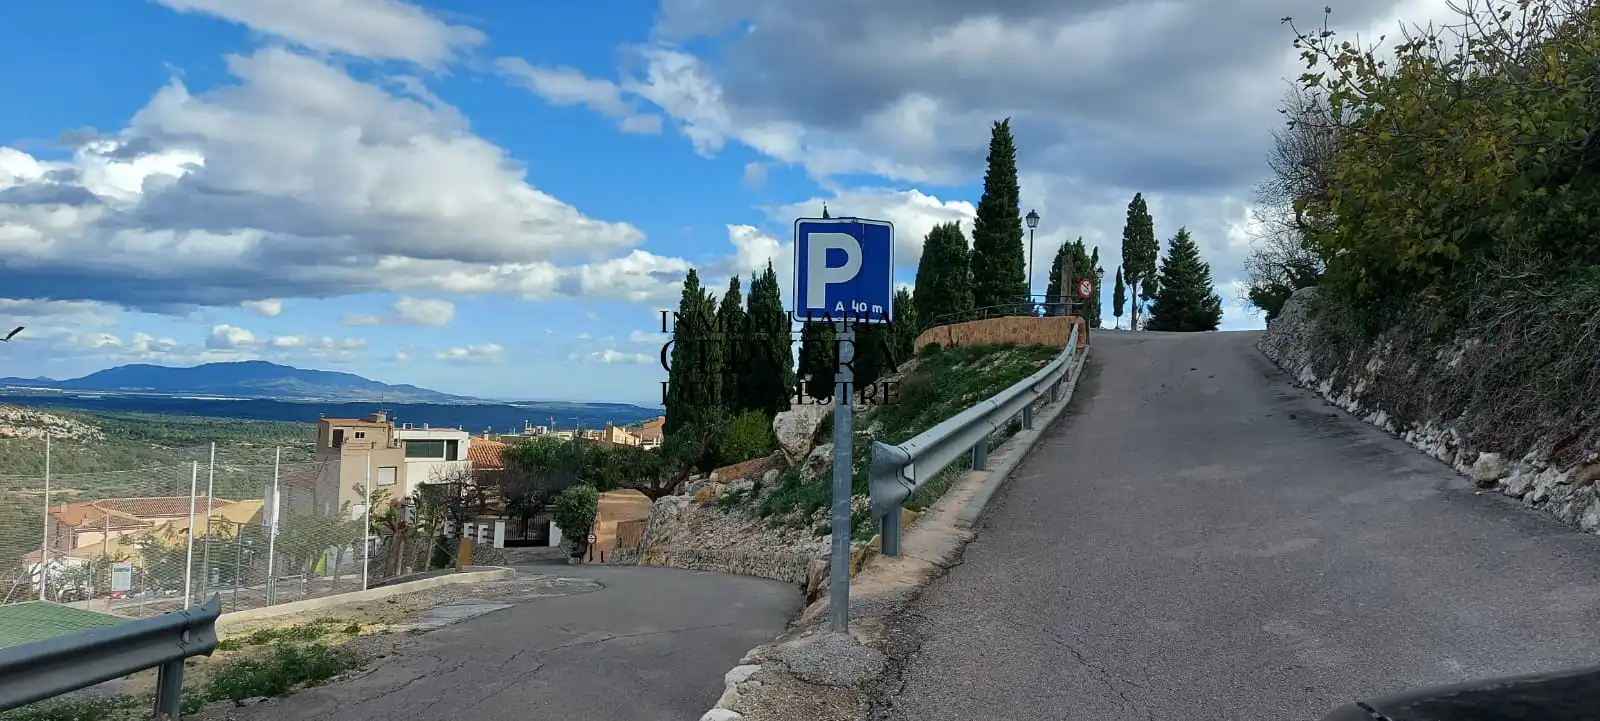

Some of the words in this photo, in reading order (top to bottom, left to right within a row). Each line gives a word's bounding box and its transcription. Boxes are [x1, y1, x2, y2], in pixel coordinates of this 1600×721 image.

[806, 232, 862, 308] P
[834, 300, 845, 312] A
[851, 299, 867, 313] 40
[871, 303, 883, 313] m
